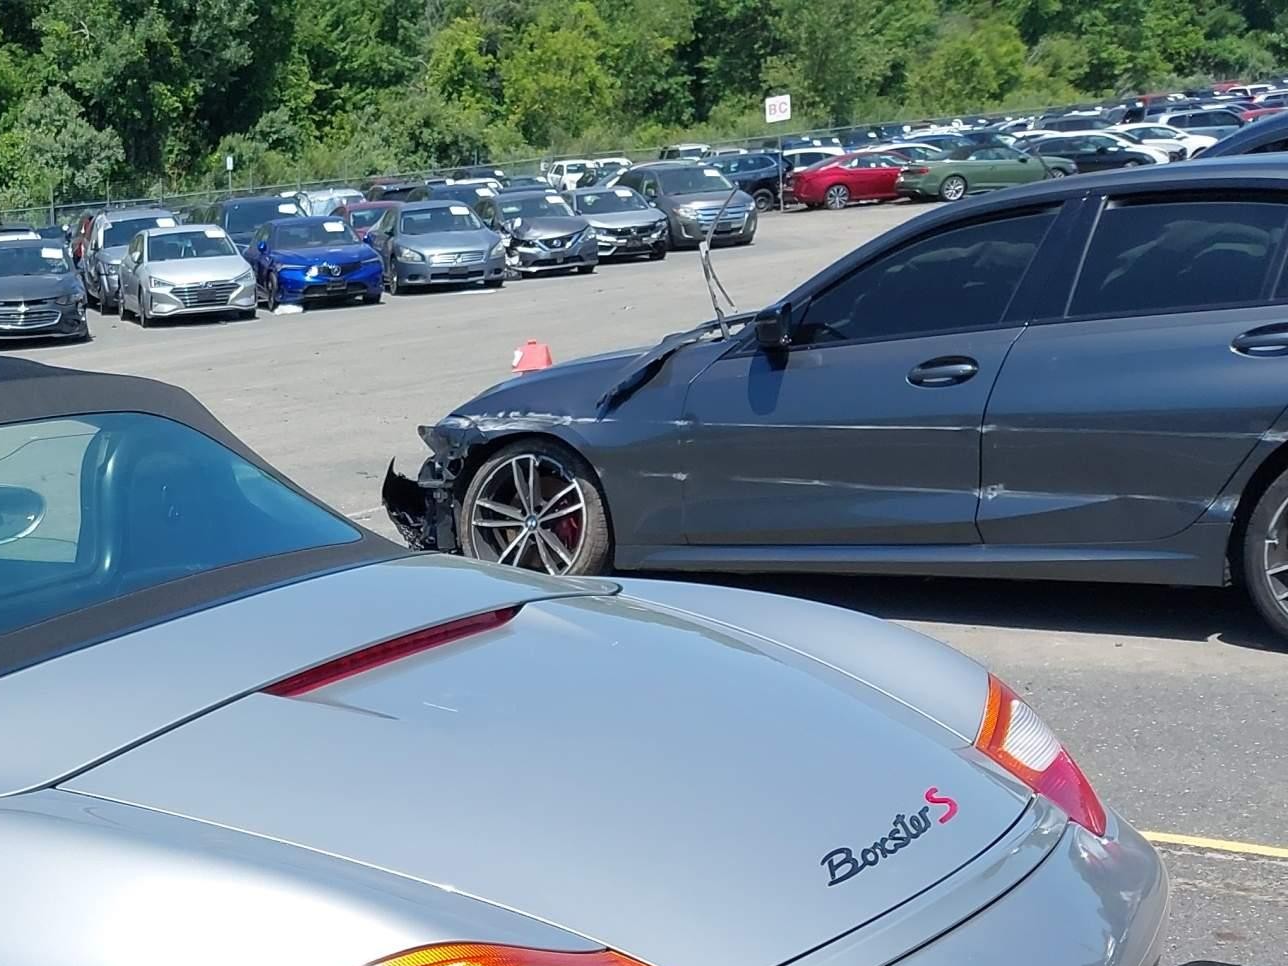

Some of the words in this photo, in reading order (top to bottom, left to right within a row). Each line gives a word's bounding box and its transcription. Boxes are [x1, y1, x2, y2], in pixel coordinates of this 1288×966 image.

[768, 101, 788, 116] BC
[819, 805, 932, 887] Boxster
[924, 786, 960, 825] S
